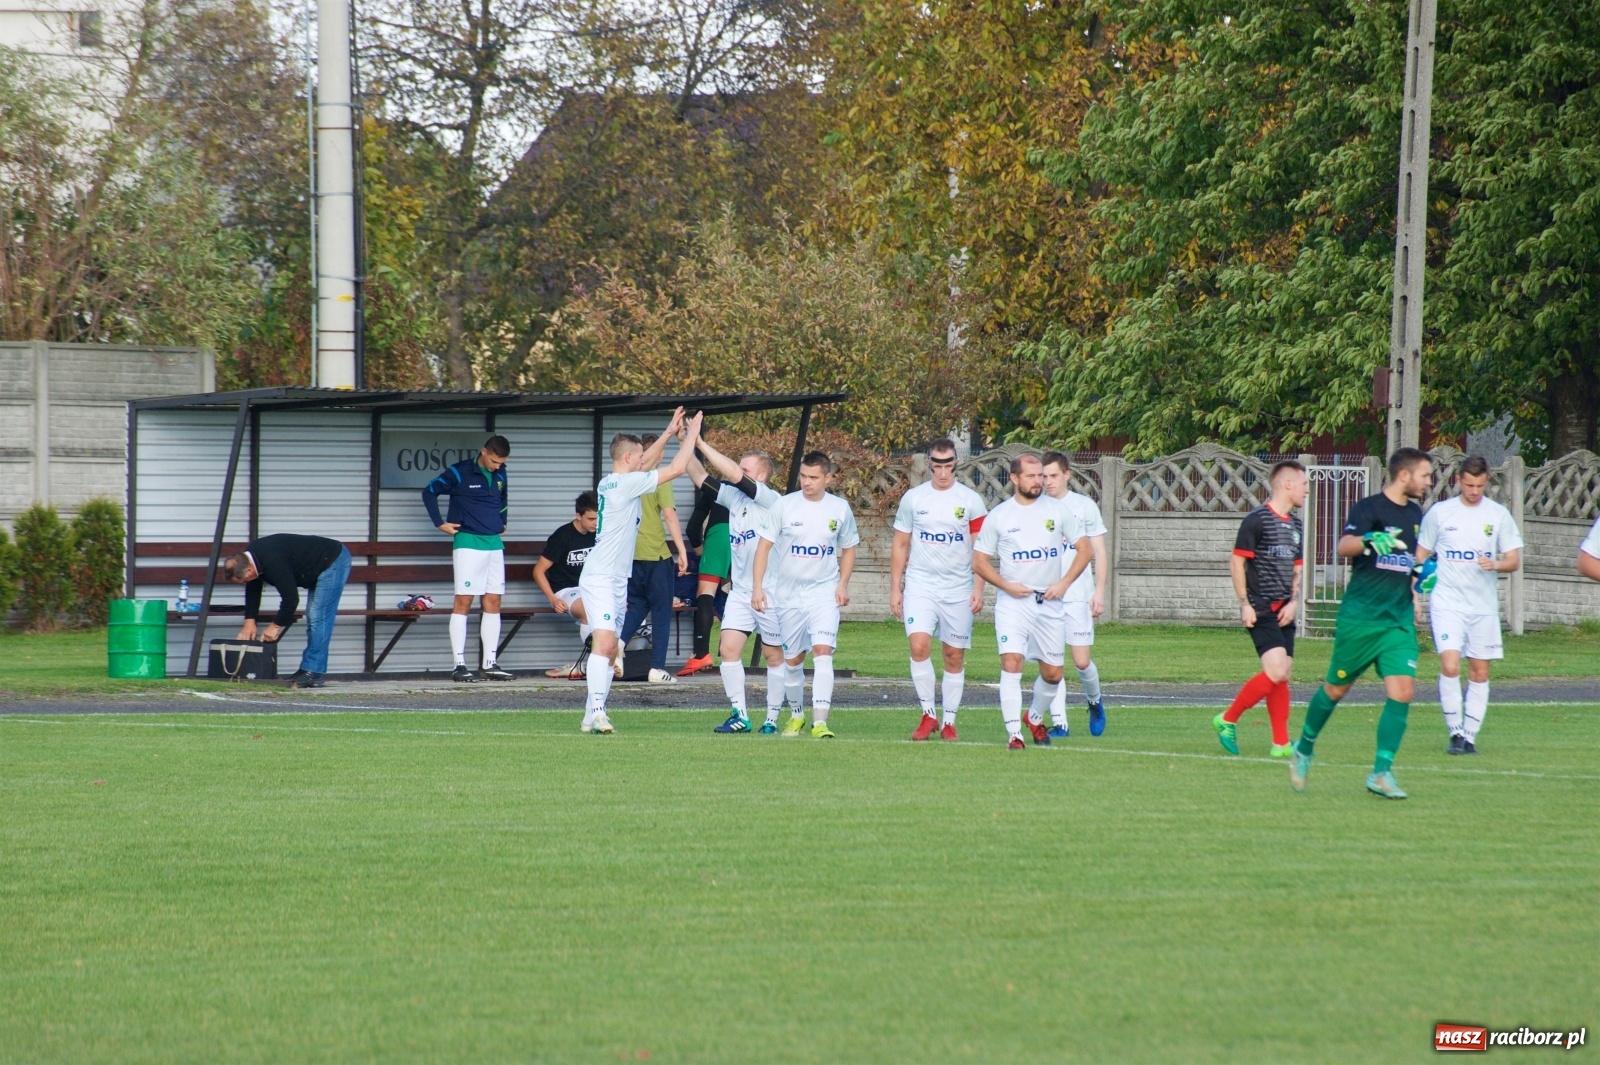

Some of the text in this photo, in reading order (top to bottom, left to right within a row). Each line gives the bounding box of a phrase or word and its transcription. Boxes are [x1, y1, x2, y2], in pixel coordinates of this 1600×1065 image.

[729, 529, 756, 546] moya
[920, 531, 964, 547] moya
[791, 543, 834, 560] moya
[1012, 545, 1058, 561] moya
